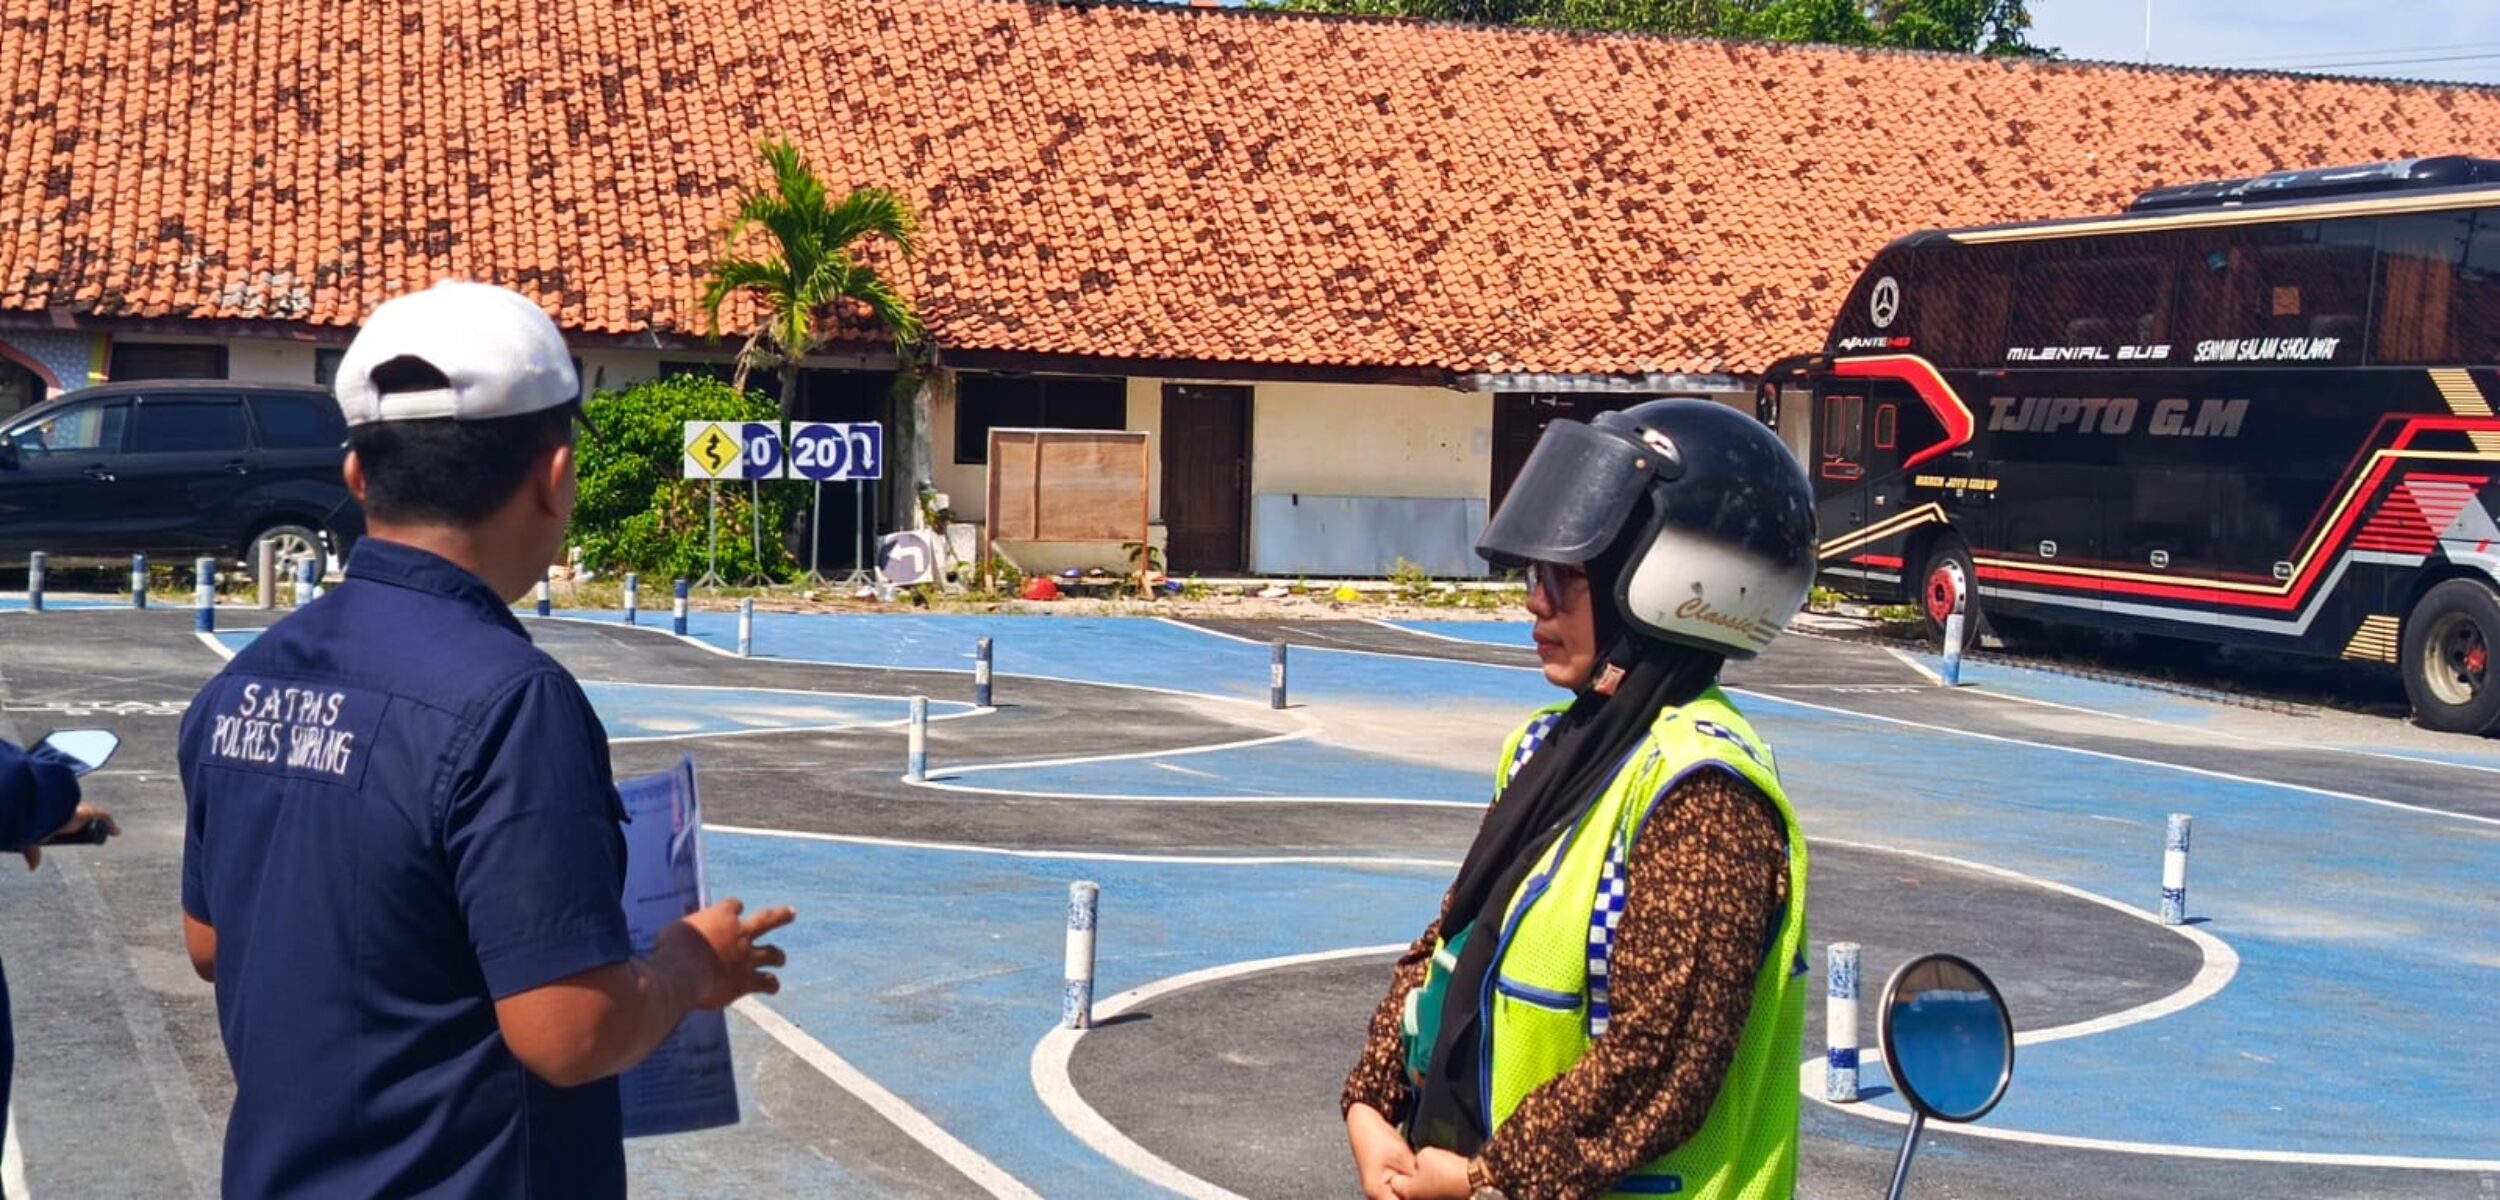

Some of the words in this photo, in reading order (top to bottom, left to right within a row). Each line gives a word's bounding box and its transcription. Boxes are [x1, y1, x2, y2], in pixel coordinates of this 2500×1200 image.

[2116, 345, 2172, 360] BUS
[2237, 337, 2279, 361] SALAM
[1988, 397, 2138, 434] TJIPTO
[795, 436, 838, 468] 20
[1675, 598, 1756, 634] Classic
[211, 714, 283, 764] POLRES
